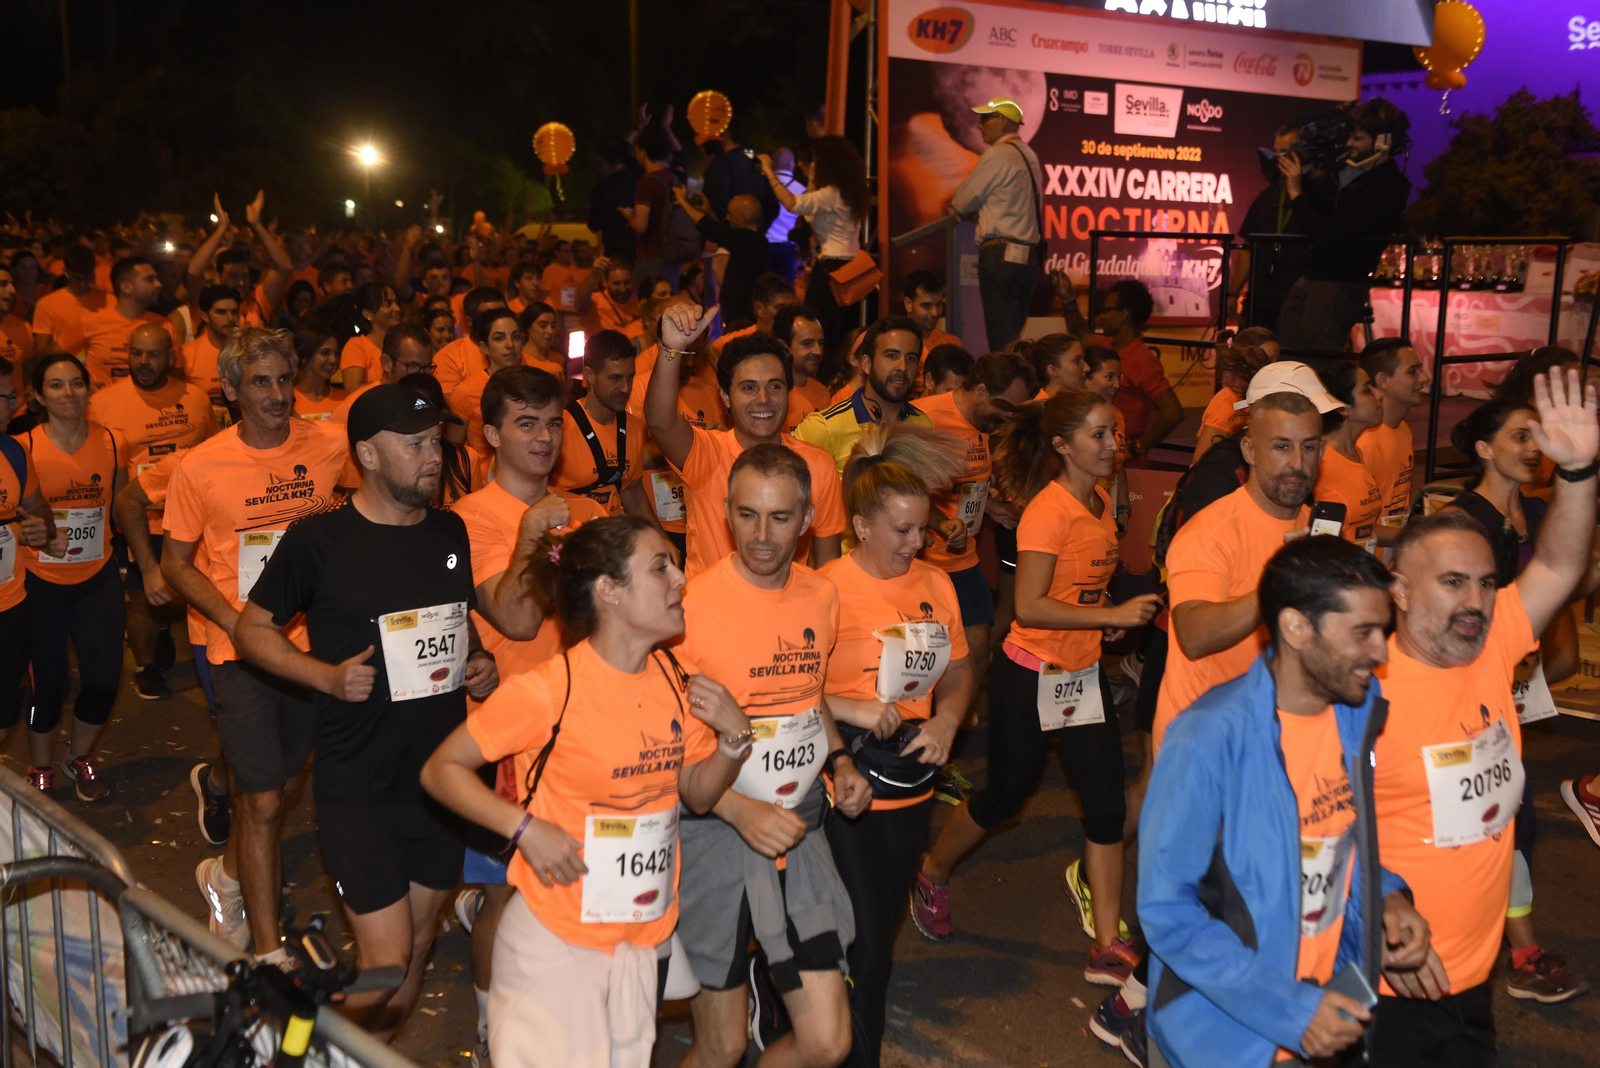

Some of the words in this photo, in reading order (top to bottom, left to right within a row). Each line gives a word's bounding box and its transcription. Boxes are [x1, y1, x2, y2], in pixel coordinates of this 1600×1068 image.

[989, 26, 1018, 43] ABC
[1032, 33, 1089, 55] Cruzcampo
[1098, 43, 1123, 56] TORRE
[1124, 46, 1155, 59] SEVILLA
[1081, 140, 1097, 155] 30
[1097, 141, 1113, 157] de
[1113, 142, 1176, 162] septiembre
[1176, 146, 1202, 162] 2022
[1044, 164, 1126, 198] XXXIV
[1126, 168, 1234, 204] CARRERA
[1044, 204, 1231, 245] NOCTURNA
[1045, 252, 1069, 275] del
[145, 419, 174, 430] SEVILLA
[66, 487, 104, 495] NOCTURNA
[265, 479, 315, 494] NOCTURNA
[48, 494, 83, 504] SEVILLA
[245, 492, 290, 507] SEVILLA
[415, 633, 456, 661] 2547
[773, 651, 821, 664] NOCTURNA
[905, 650, 937, 671] 6750
[749, 664, 797, 678] SEVILLA
[1055, 679, 1084, 699] 9774
[639, 745, 685, 761] NOCTURN
[761, 742, 815, 773] 16423
[611, 761, 663, 780] SEVILLA
[1460, 758, 1512, 802] 20796
[616, 846, 672, 878] 16426
